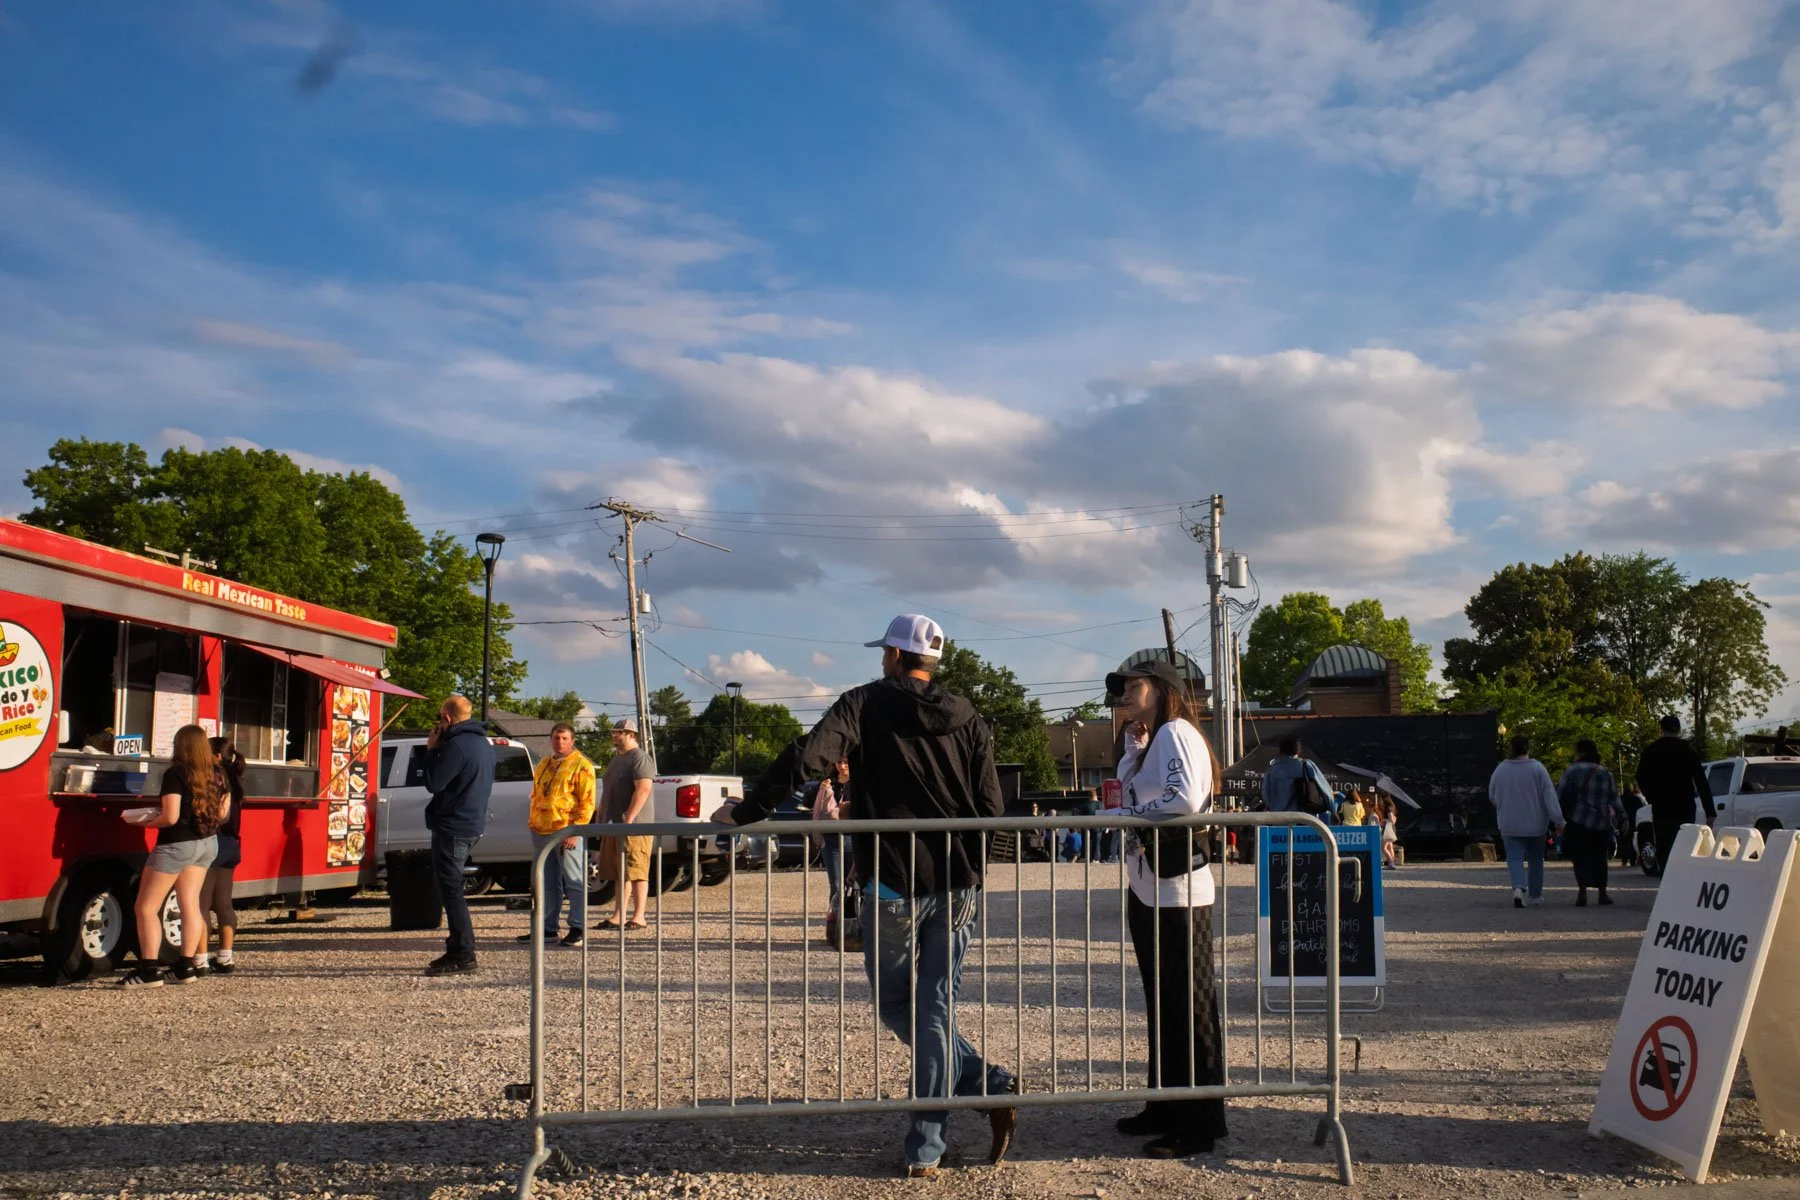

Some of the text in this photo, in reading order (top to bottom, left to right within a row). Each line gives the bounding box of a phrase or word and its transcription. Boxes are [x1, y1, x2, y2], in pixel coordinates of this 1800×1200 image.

[182, 572, 306, 620] Real Mexican Taste
[2, 703, 35, 722] Rico
[15, 721, 32, 733] Food
[117, 739, 140, 755] OPEN
[1227, 779, 1246, 790] THE
[1271, 834, 1296, 844] BU
[1296, 834, 1324, 844] LIGH
[1696, 881, 1729, 911] NO
[1281, 918, 1361, 935] BATHROMS
[1654, 921, 1748, 963] PARKING
[1654, 967, 1723, 1008] TODAY
